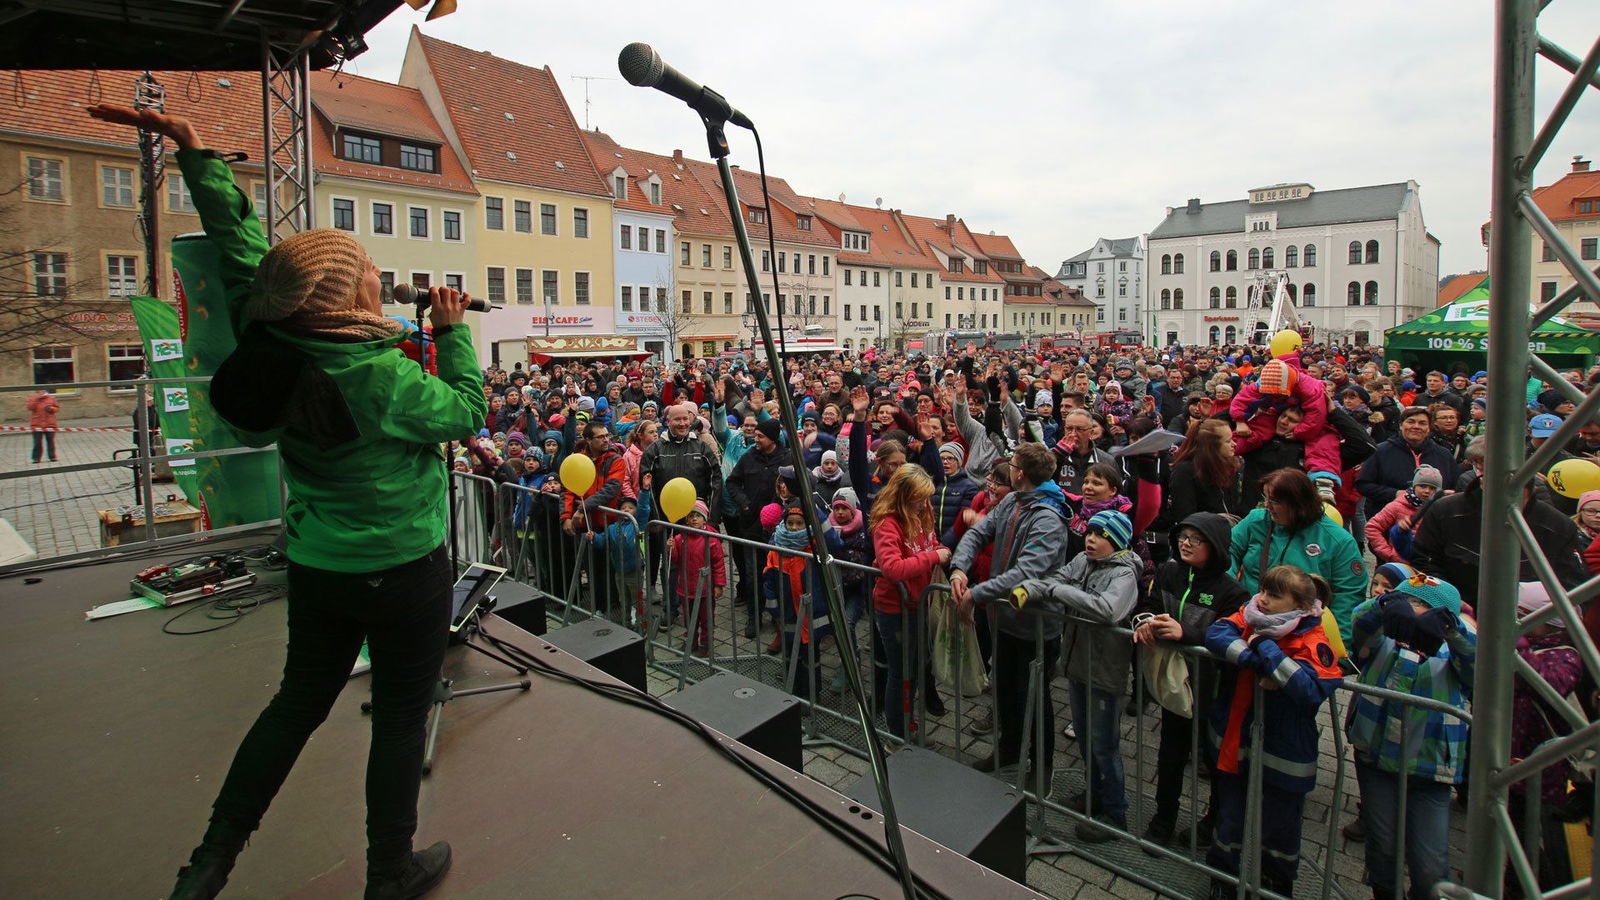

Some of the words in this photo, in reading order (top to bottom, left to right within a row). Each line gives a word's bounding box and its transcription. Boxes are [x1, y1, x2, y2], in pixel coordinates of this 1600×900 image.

[532, 316, 548, 324] EIS
[1427, 337, 1452, 349] 100
[1458, 338, 1475, 350] %
